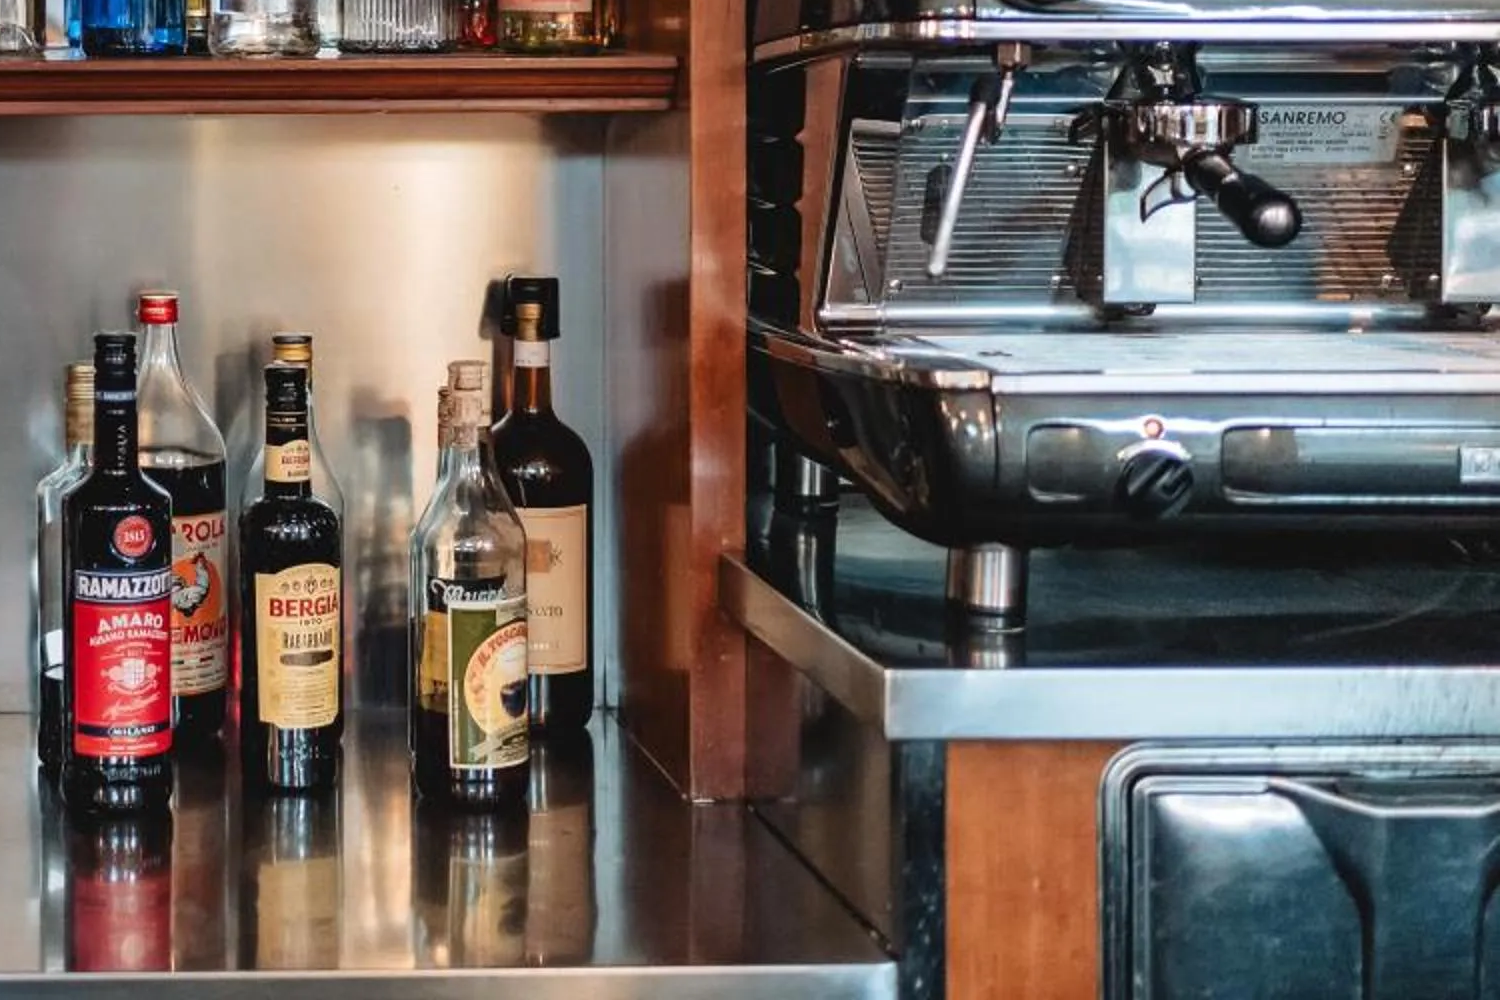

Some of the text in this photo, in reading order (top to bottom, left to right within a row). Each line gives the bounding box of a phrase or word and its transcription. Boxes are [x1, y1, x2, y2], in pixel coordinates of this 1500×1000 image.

[1260, 111, 1346, 125] SANREMO
[270, 596, 338, 618] BERGIA
[99, 612, 164, 635] AMARO
